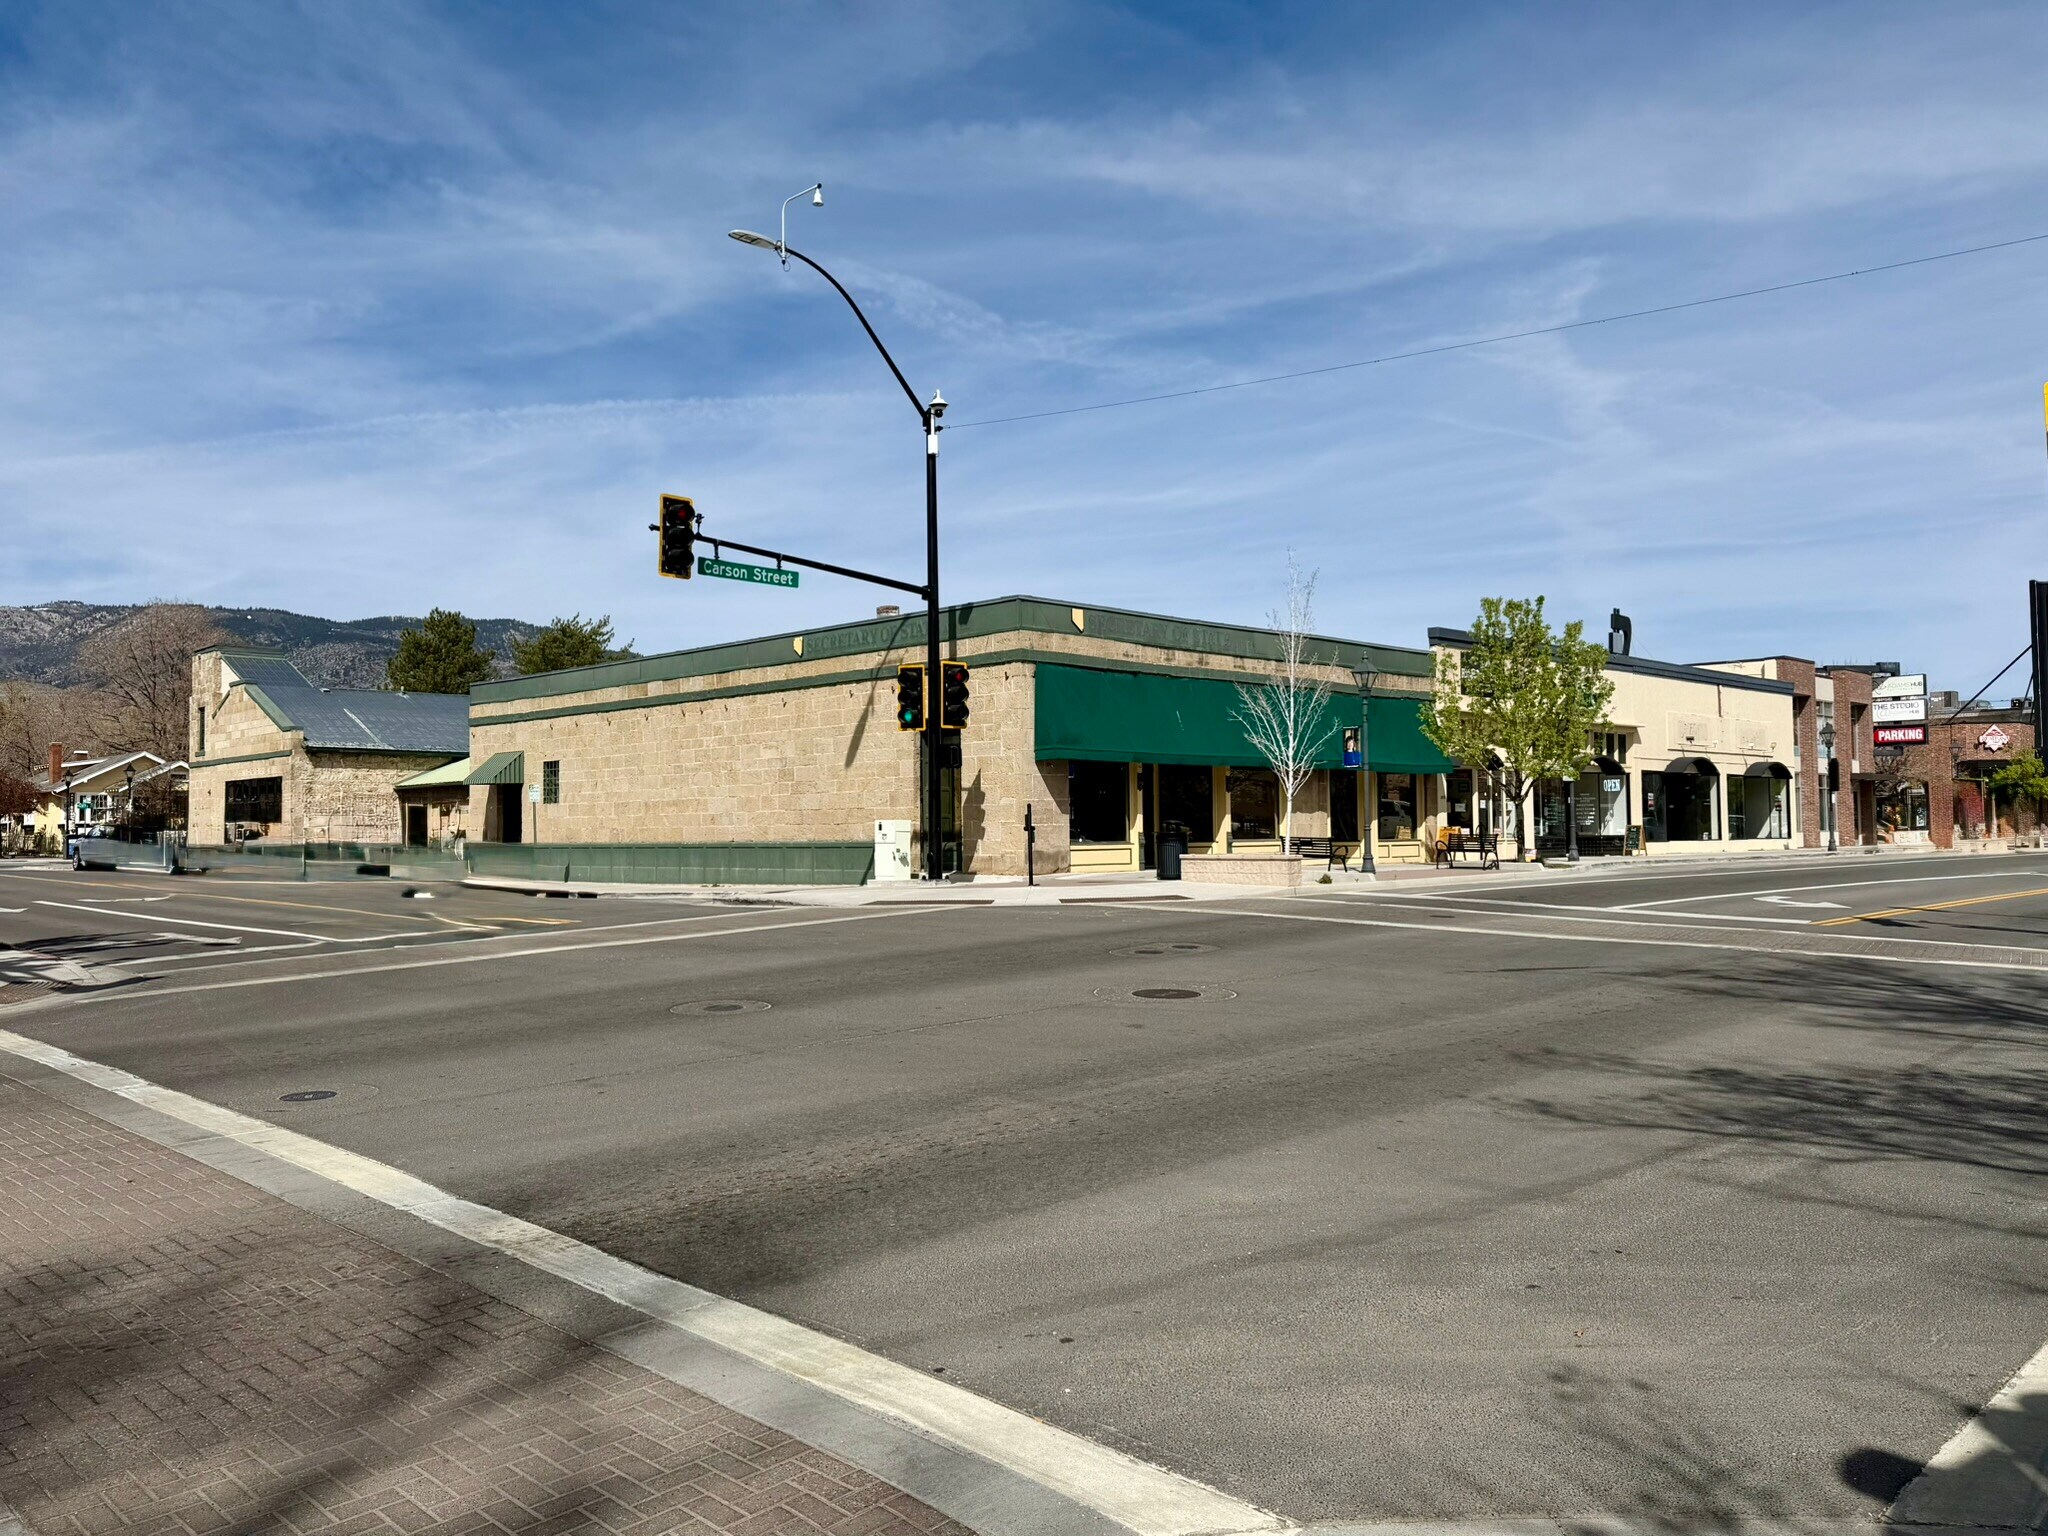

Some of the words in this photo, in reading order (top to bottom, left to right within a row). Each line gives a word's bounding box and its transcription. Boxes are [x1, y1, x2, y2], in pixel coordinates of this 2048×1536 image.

[703, 560, 748, 579] Carson
[753, 568, 793, 585] Street
[807, 627, 877, 653] SECRETARY
[1890, 702, 1919, 710] STUDIO
[1878, 728, 1922, 741] PARKING
[1603, 779, 1621, 792] OPEN
